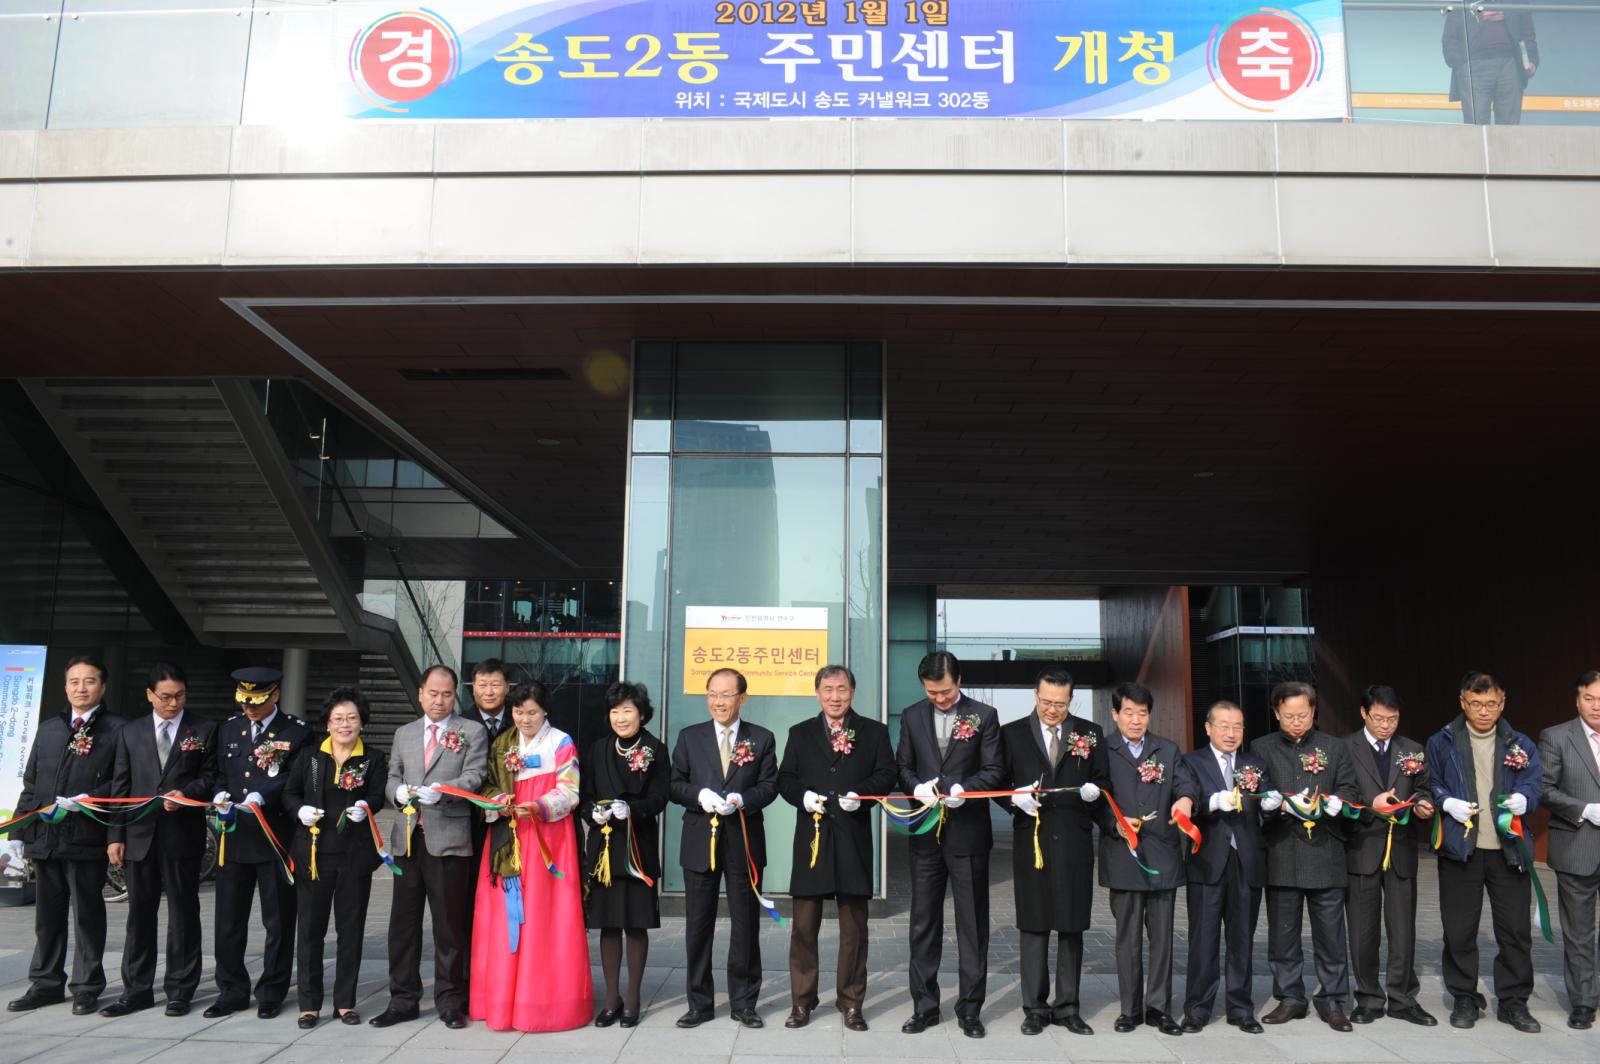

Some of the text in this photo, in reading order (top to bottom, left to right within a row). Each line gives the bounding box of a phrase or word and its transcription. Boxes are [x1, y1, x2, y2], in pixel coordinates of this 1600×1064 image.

[715, 0, 949, 26] 2012년 1월 1일
[378, 29, 433, 88] 경
[494, 30, 1174, 85] 송도2동 주민센터 개청
[1236, 27, 1294, 90] 축
[675, 91, 710, 109] 위치
[733, 91, 806, 109] 국제도시
[814, 91, 850, 108] 송도
[857, 91, 931, 109] 커낼워크
[938, 91, 990, 109] 302동
[692, 646, 819, 665] 송도2동주민센터
[12, 674, 22, 705] Songdo
